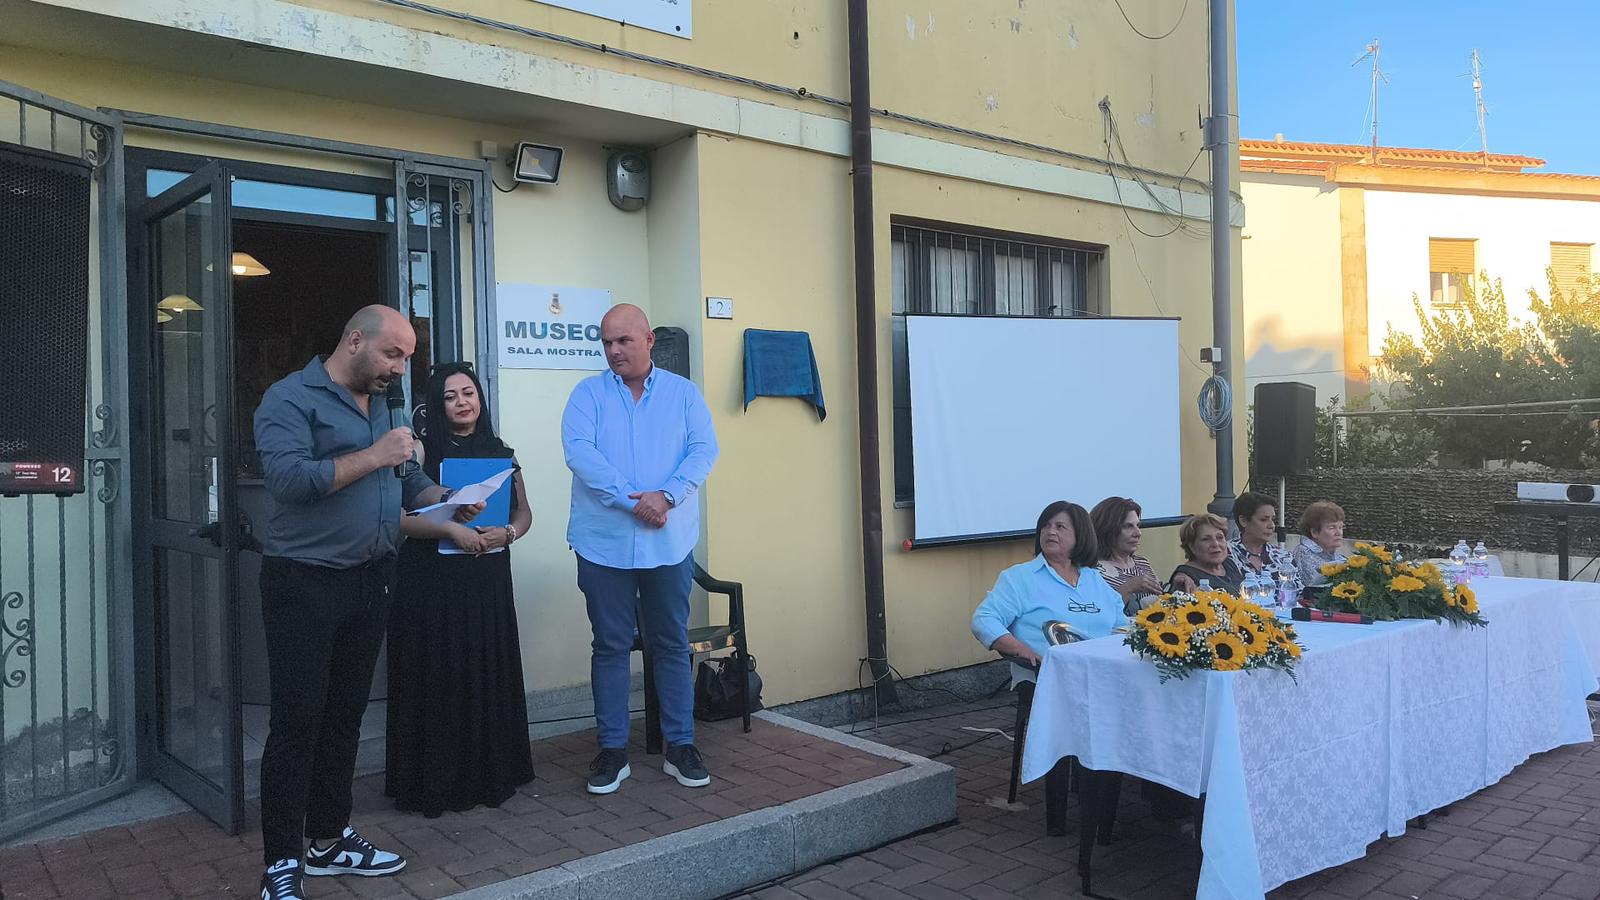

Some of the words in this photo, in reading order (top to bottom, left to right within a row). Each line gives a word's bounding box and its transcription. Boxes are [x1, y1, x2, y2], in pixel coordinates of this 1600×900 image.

[504, 320, 602, 342] MUSEO
[507, 346, 543, 355] SALA
[547, 348, 602, 357] MOSTRA
[52, 467, 71, 482] 12
